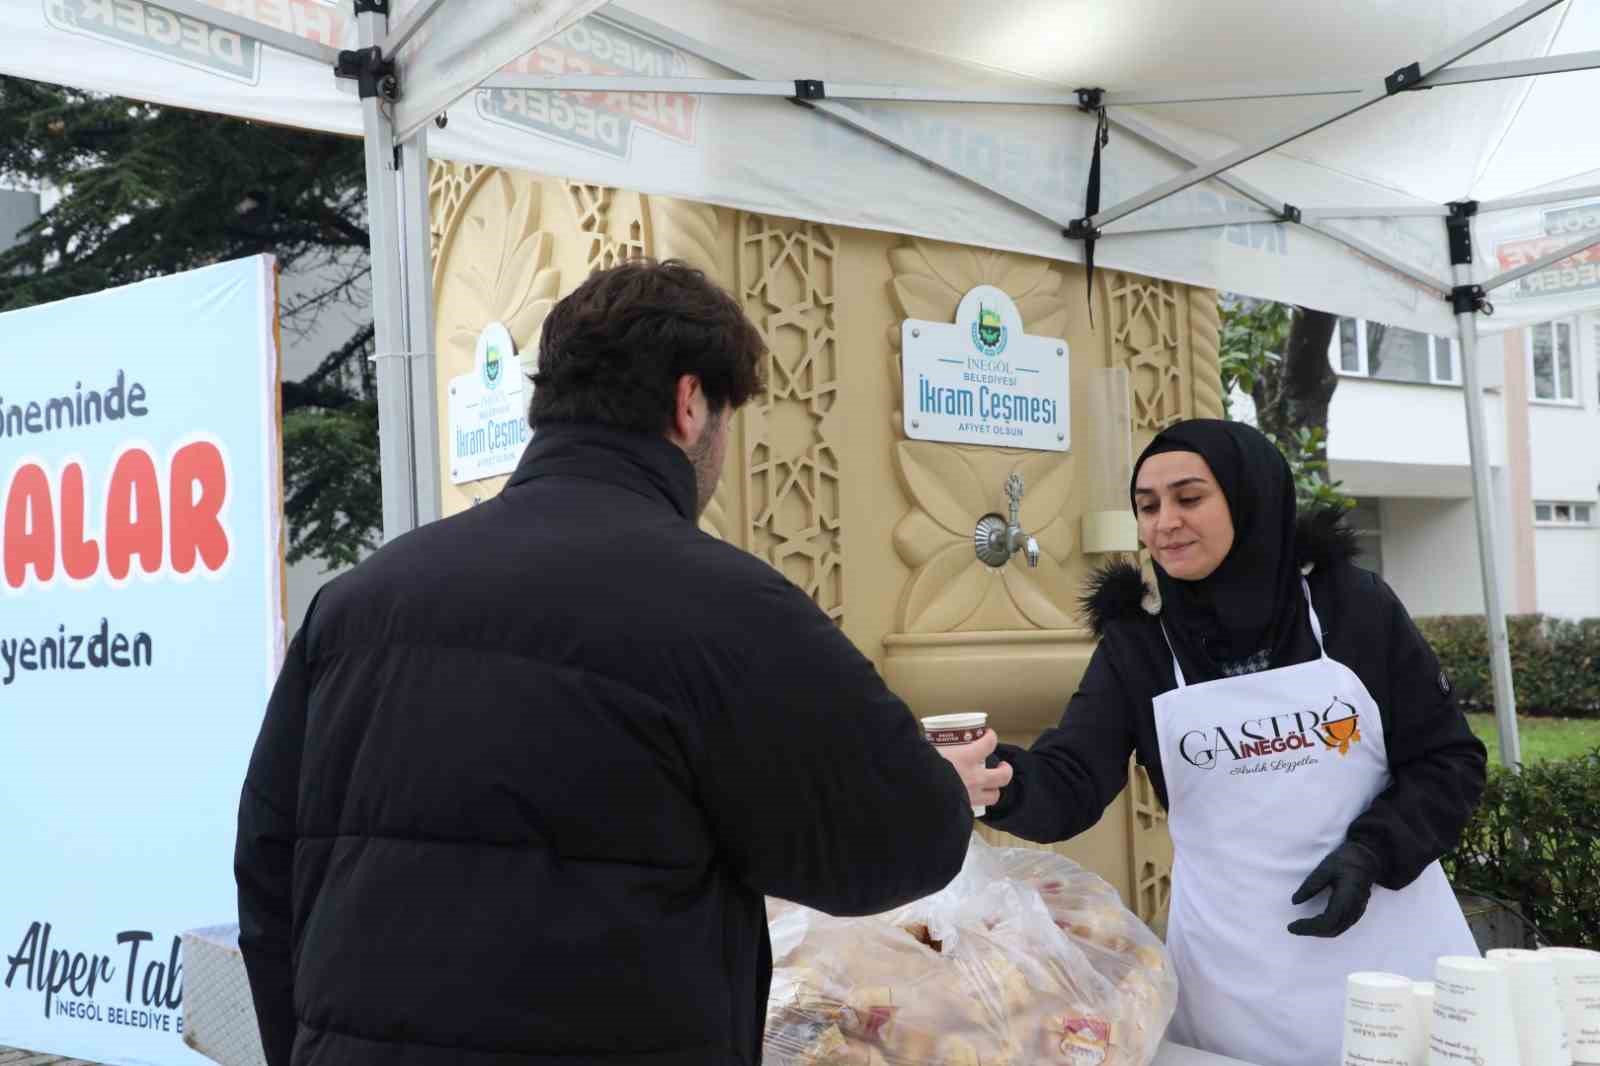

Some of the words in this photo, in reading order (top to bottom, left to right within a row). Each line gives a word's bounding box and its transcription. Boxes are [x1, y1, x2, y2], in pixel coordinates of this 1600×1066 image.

[0, 369, 149, 437] neminde
[919, 373, 974, 417] İkram
[979, 385, 1057, 425] Çeşmesi
[3, 440, 229, 589] ALAR
[0, 617, 152, 685] yenizden
[1239, 731, 1315, 760] İNEGÖL
[4, 921, 115, 1018] Alper
[55, 996, 103, 1023] İNEGÖL
[107, 1006, 170, 1033] BELEDİYE
